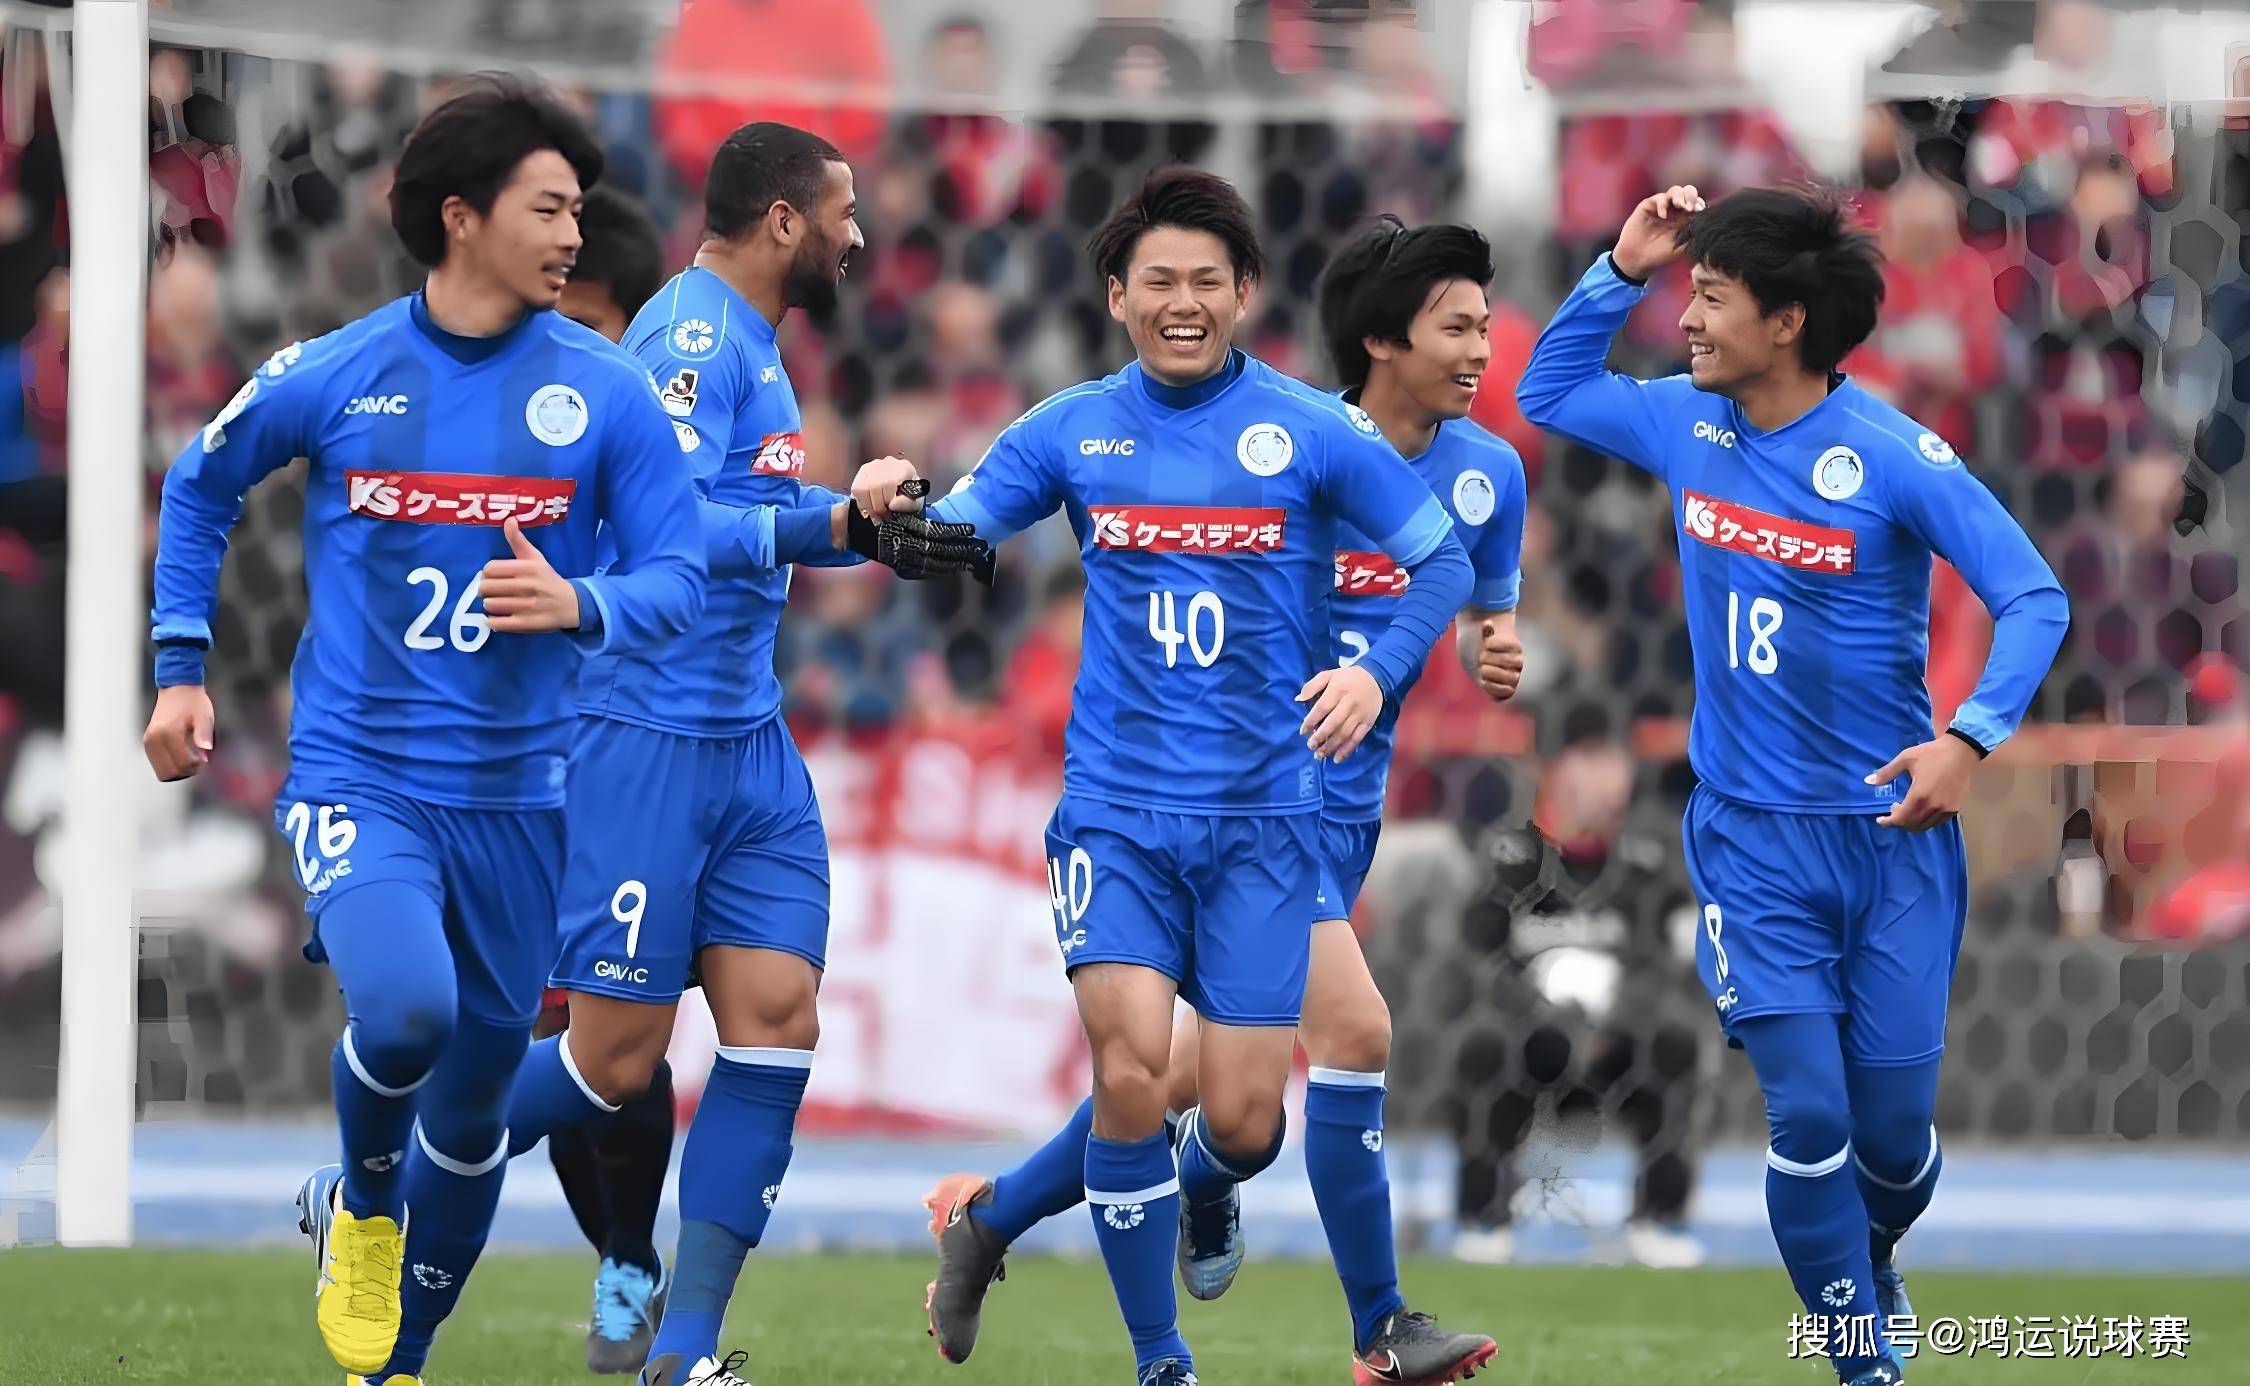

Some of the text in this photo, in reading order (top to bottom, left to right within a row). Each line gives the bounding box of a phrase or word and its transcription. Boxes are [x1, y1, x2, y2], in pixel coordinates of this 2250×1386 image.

[404, 566, 491, 653] 26
[1149, 590, 1225, 668] 40
[1728, 591, 1784, 675] 18
[285, 801, 357, 886] 26
[610, 879, 647, 958] 9
[1047, 847, 1093, 931] 40
